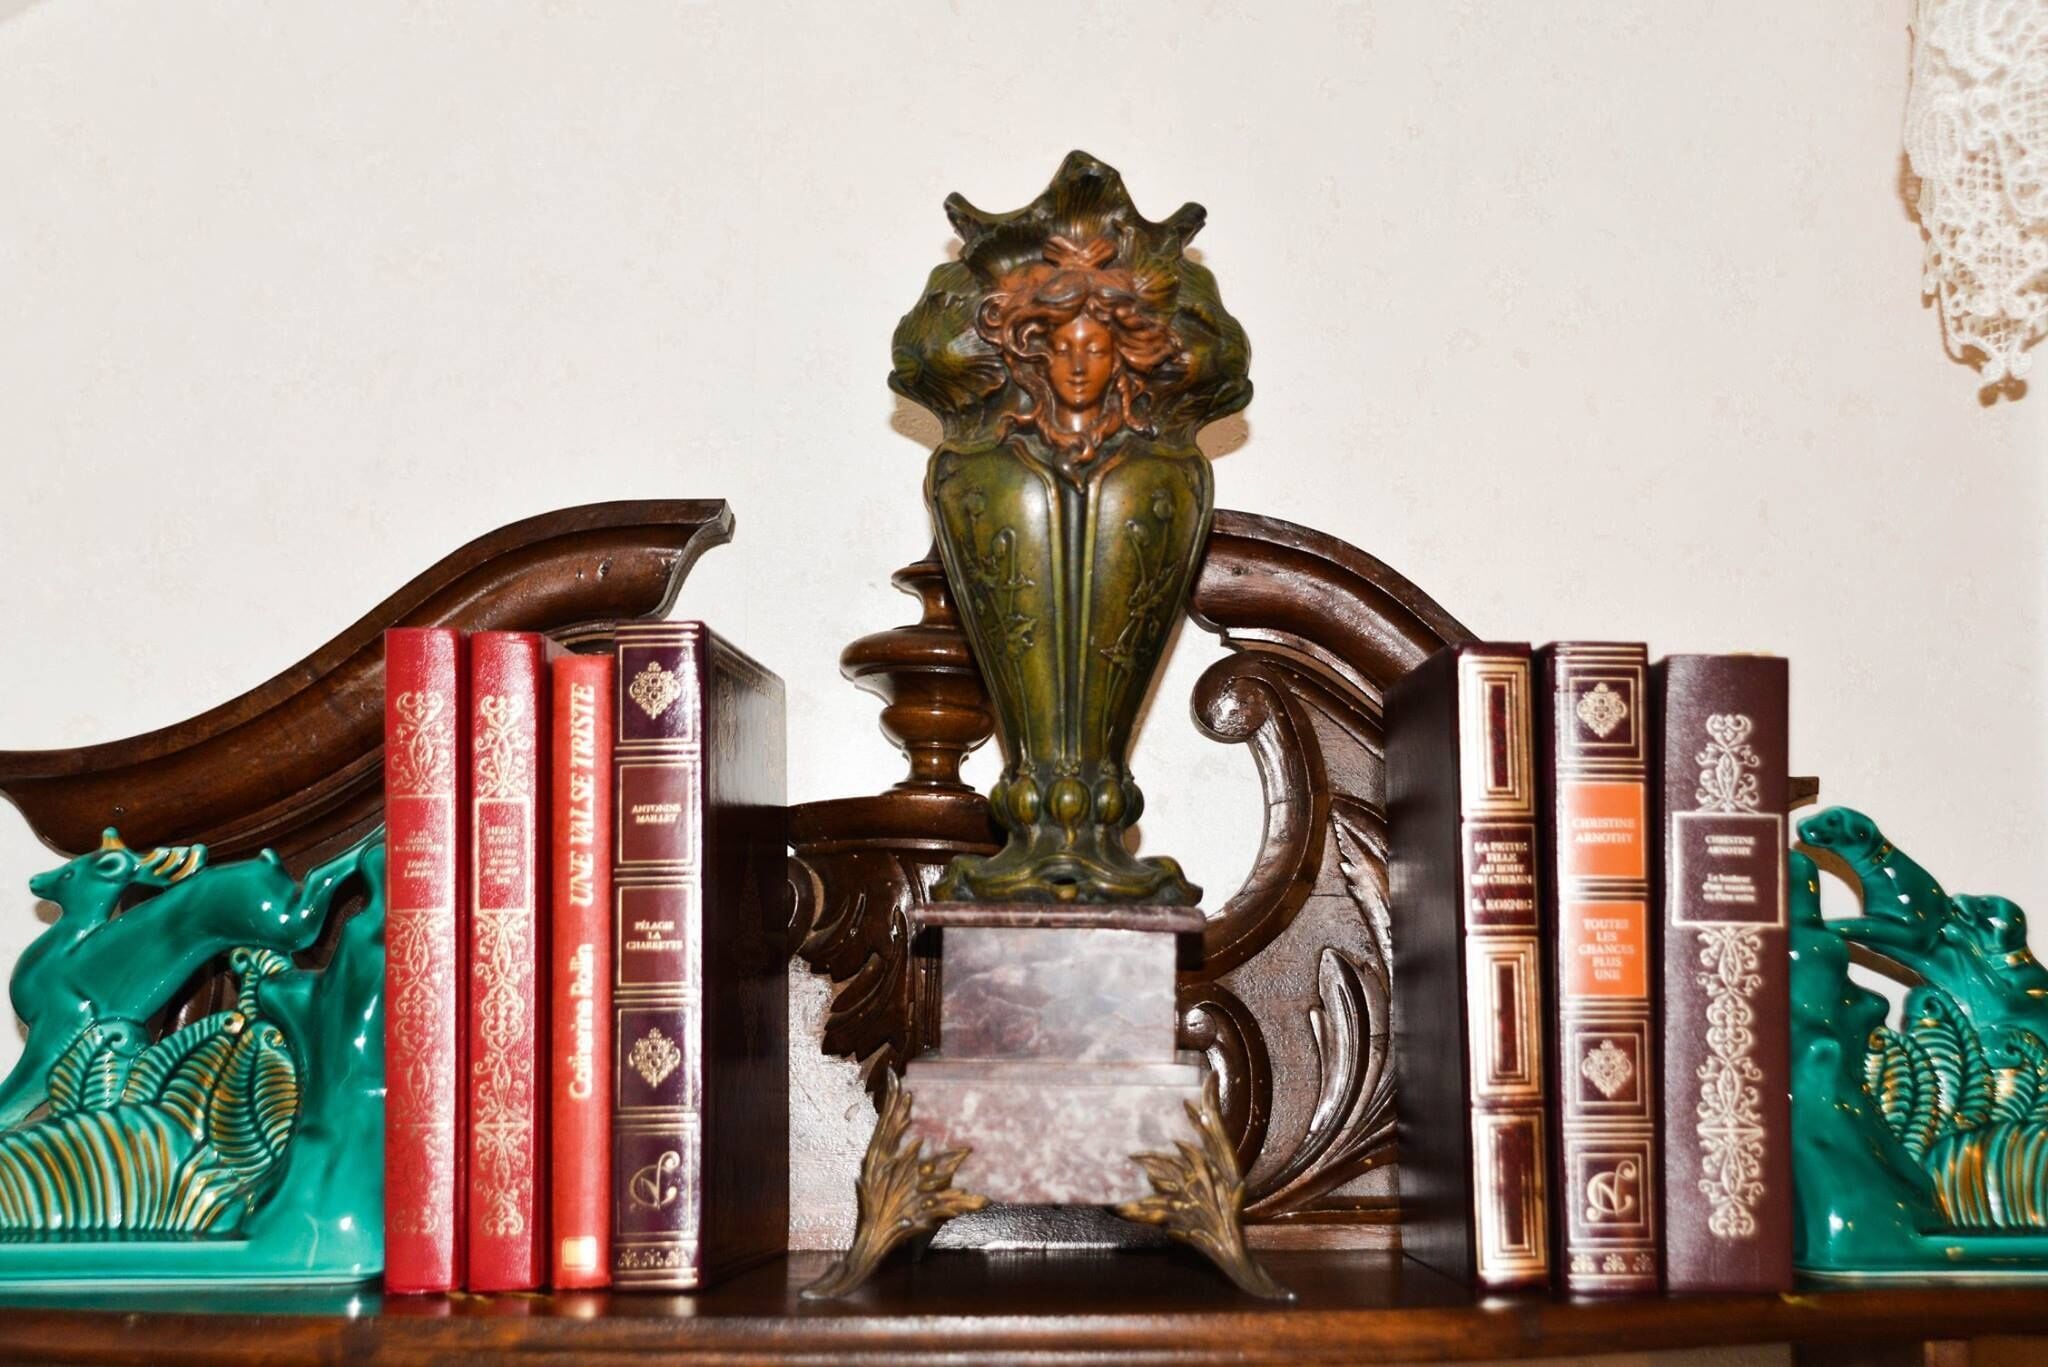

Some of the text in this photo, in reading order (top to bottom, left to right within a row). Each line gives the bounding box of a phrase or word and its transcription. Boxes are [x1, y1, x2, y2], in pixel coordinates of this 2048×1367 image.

[569, 682, 596, 908] UNE VALSE TRISTE
[1571, 817, 1635, 829] CHRISTINE
[1574, 831, 1633, 844] ARNOTHY
[648, 931, 662, 940] LA
[1595, 931, 1617, 942] LES
[1591, 956, 1622, 968] PLUS
[567, 998, 594, 1100] Catherine
